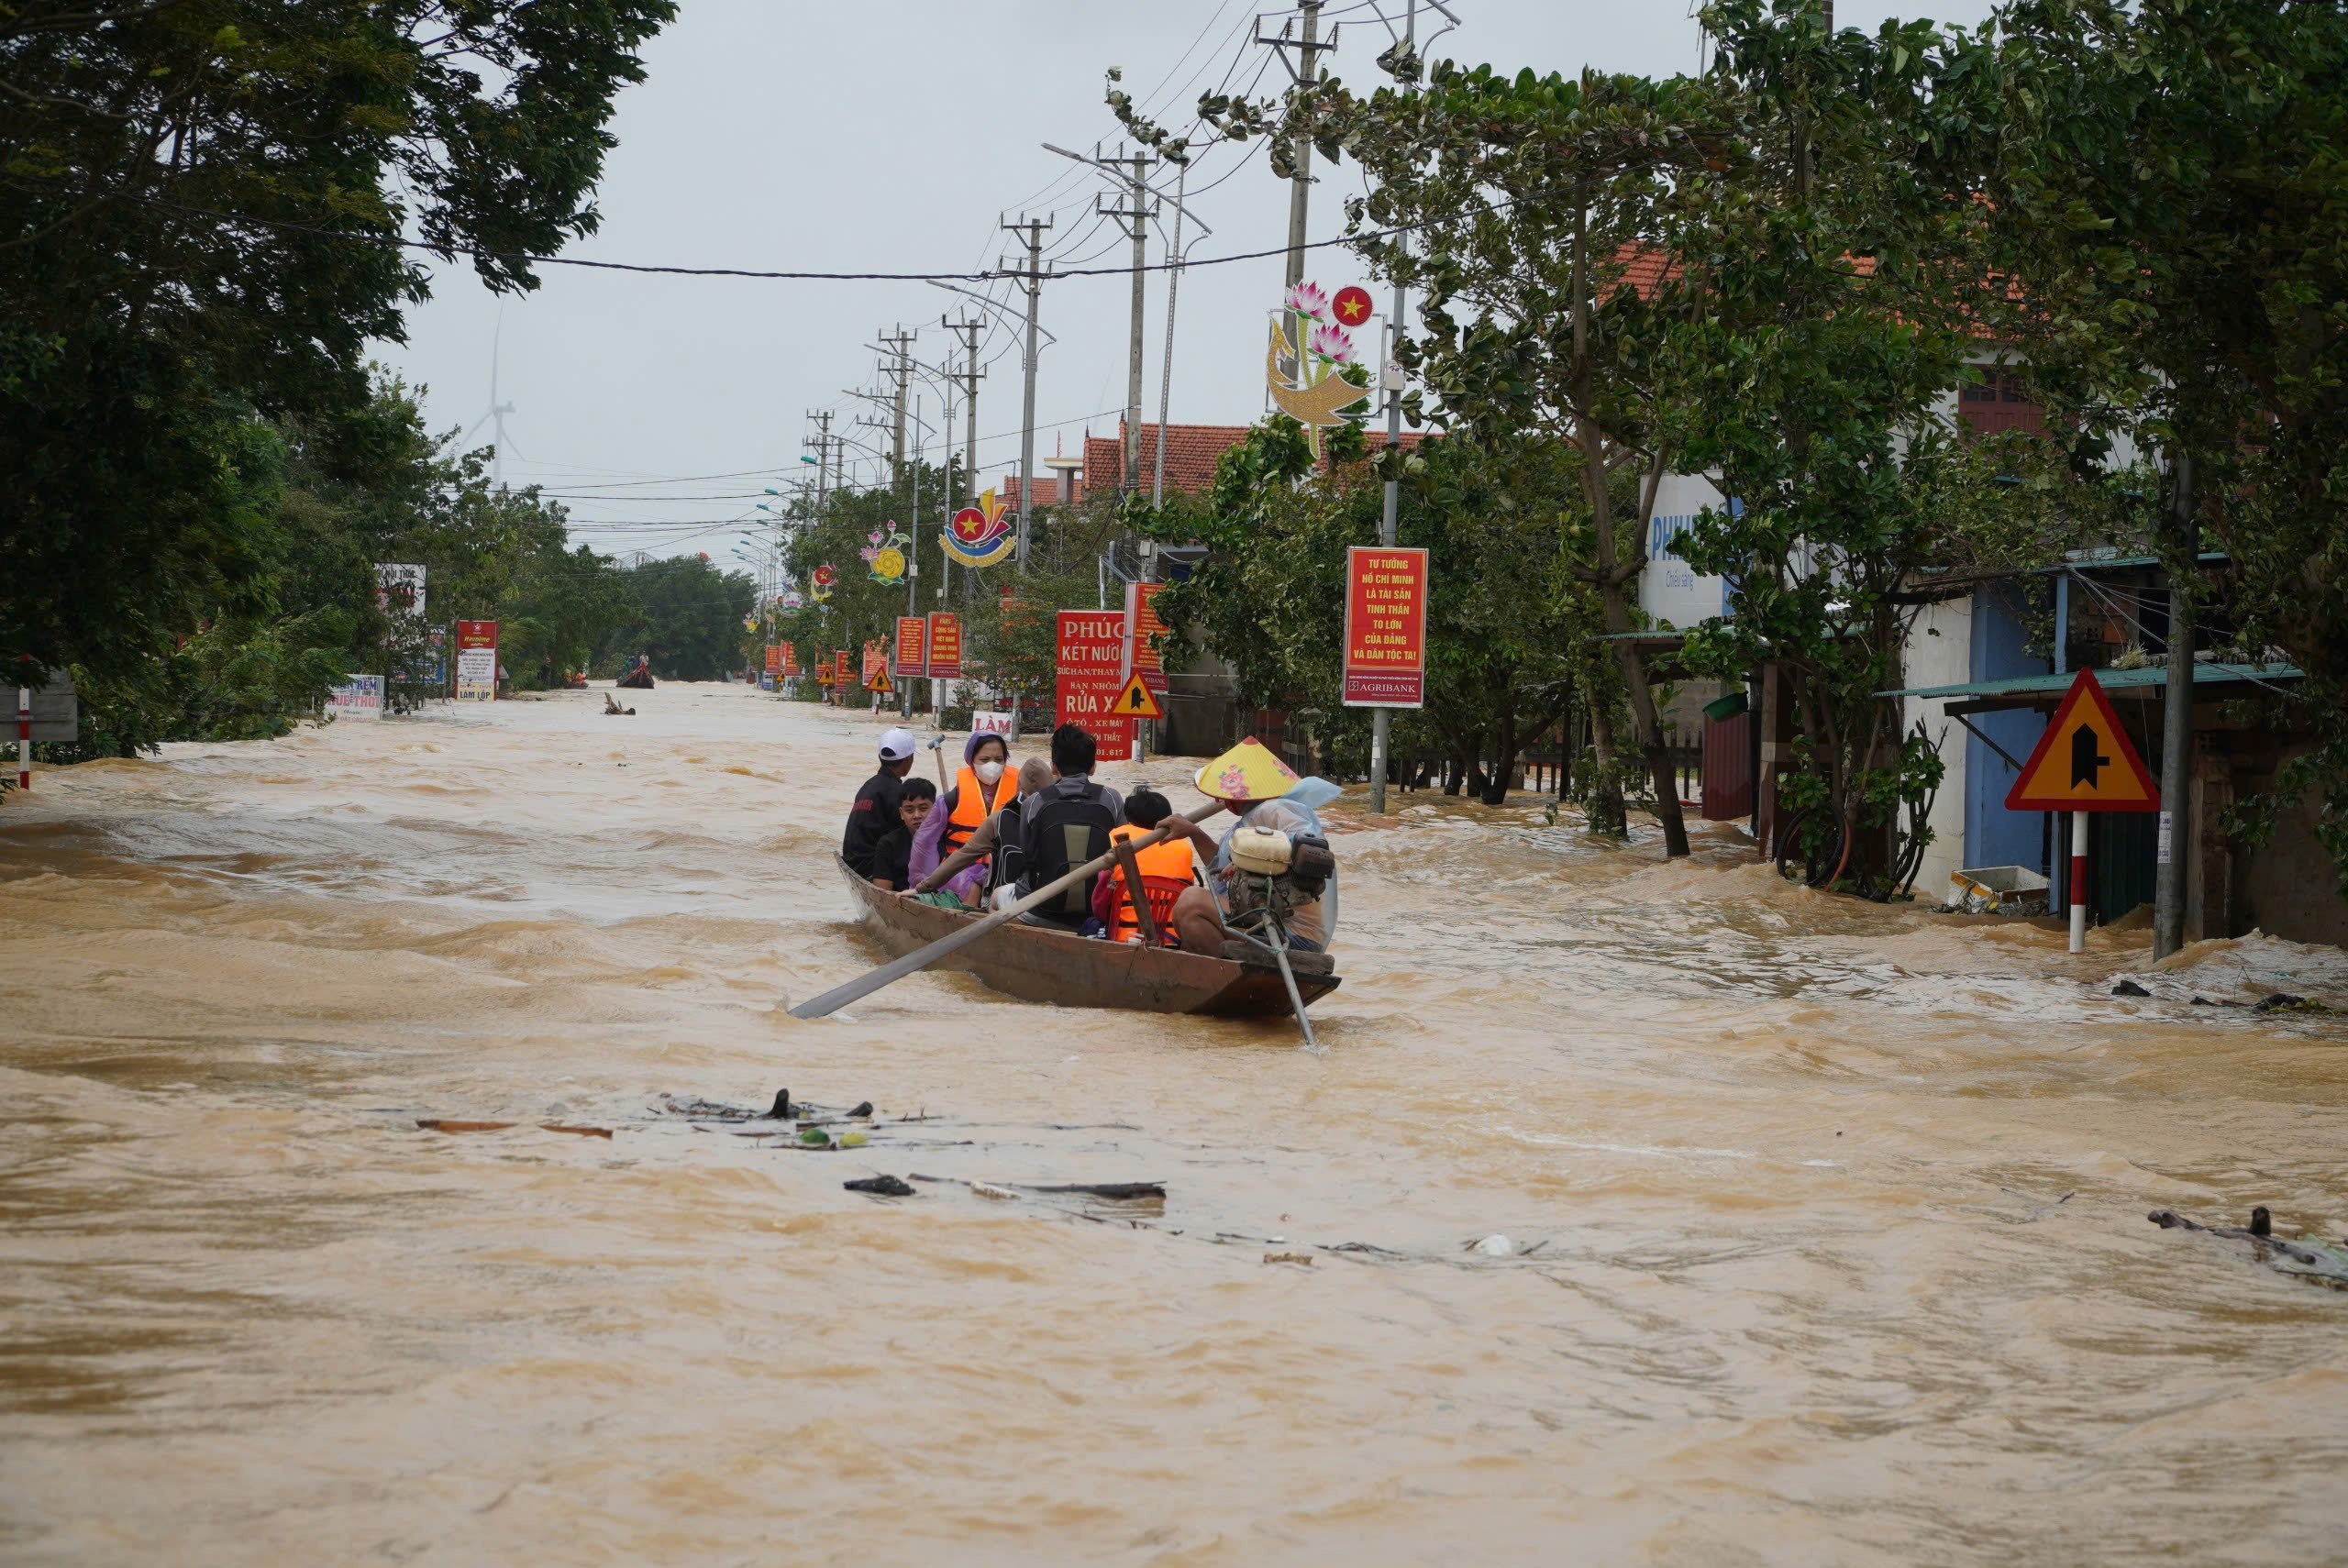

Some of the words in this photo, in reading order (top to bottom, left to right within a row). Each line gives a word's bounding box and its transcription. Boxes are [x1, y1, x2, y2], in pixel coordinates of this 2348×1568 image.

[1392, 575, 1414, 584] MINH
[1367, 605, 1385, 614] TINH
[1373, 620, 1383, 629] TO
[1092, 643, 1124, 661] NƯỚ
[1360, 684, 1416, 693] AGRIBANK
[460, 690, 475, 698] LÀM
[1067, 690, 1097, 712] RỬA
[975, 715, 1011, 733] LÀM
